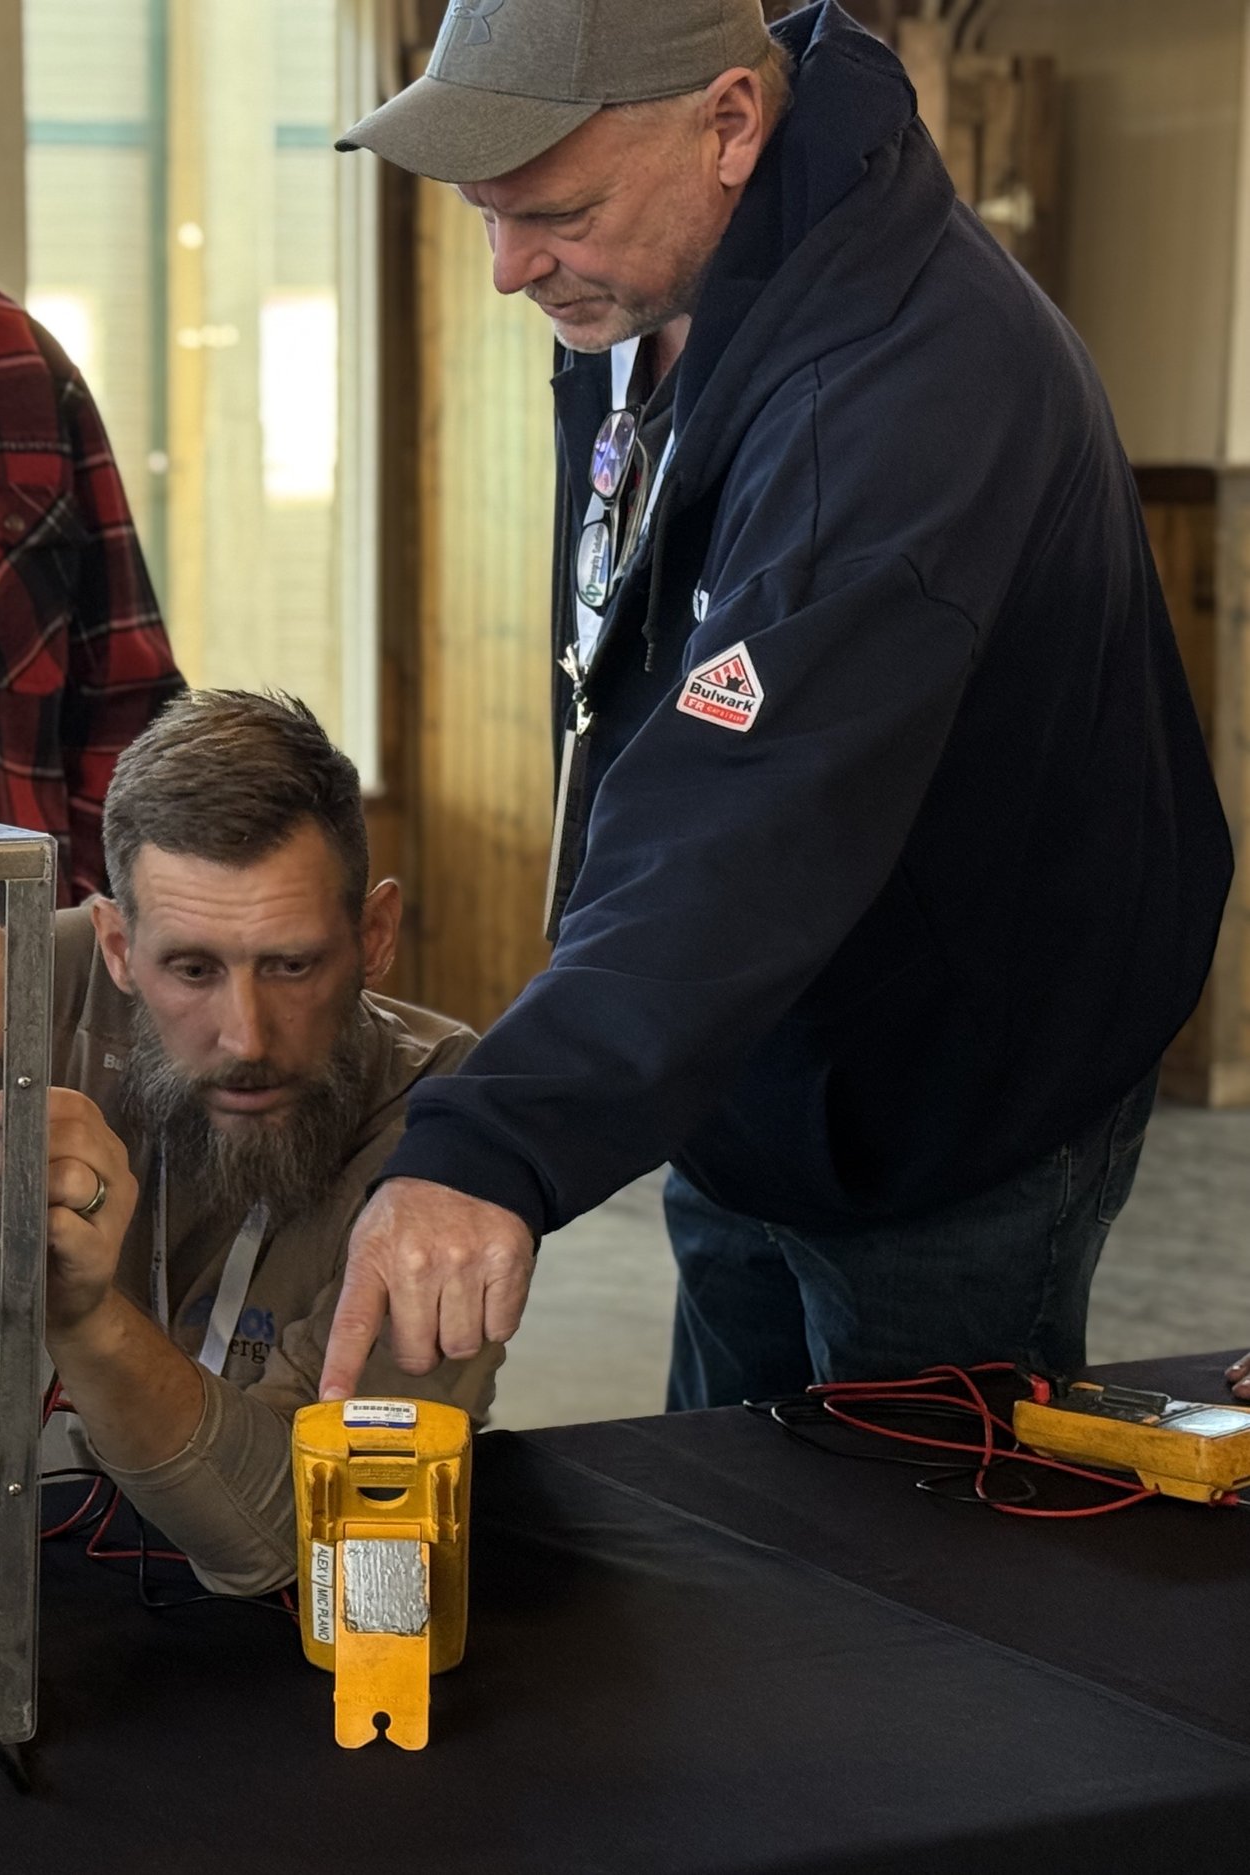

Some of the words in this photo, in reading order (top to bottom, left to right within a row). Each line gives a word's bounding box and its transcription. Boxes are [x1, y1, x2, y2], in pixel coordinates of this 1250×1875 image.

[687, 698, 705, 712] FR
[690, 681, 755, 713] Bulwark
[316, 1545, 330, 1571] ALEX
[316, 1574, 329, 1583] V
[317, 1607, 330, 1641] PLANO
